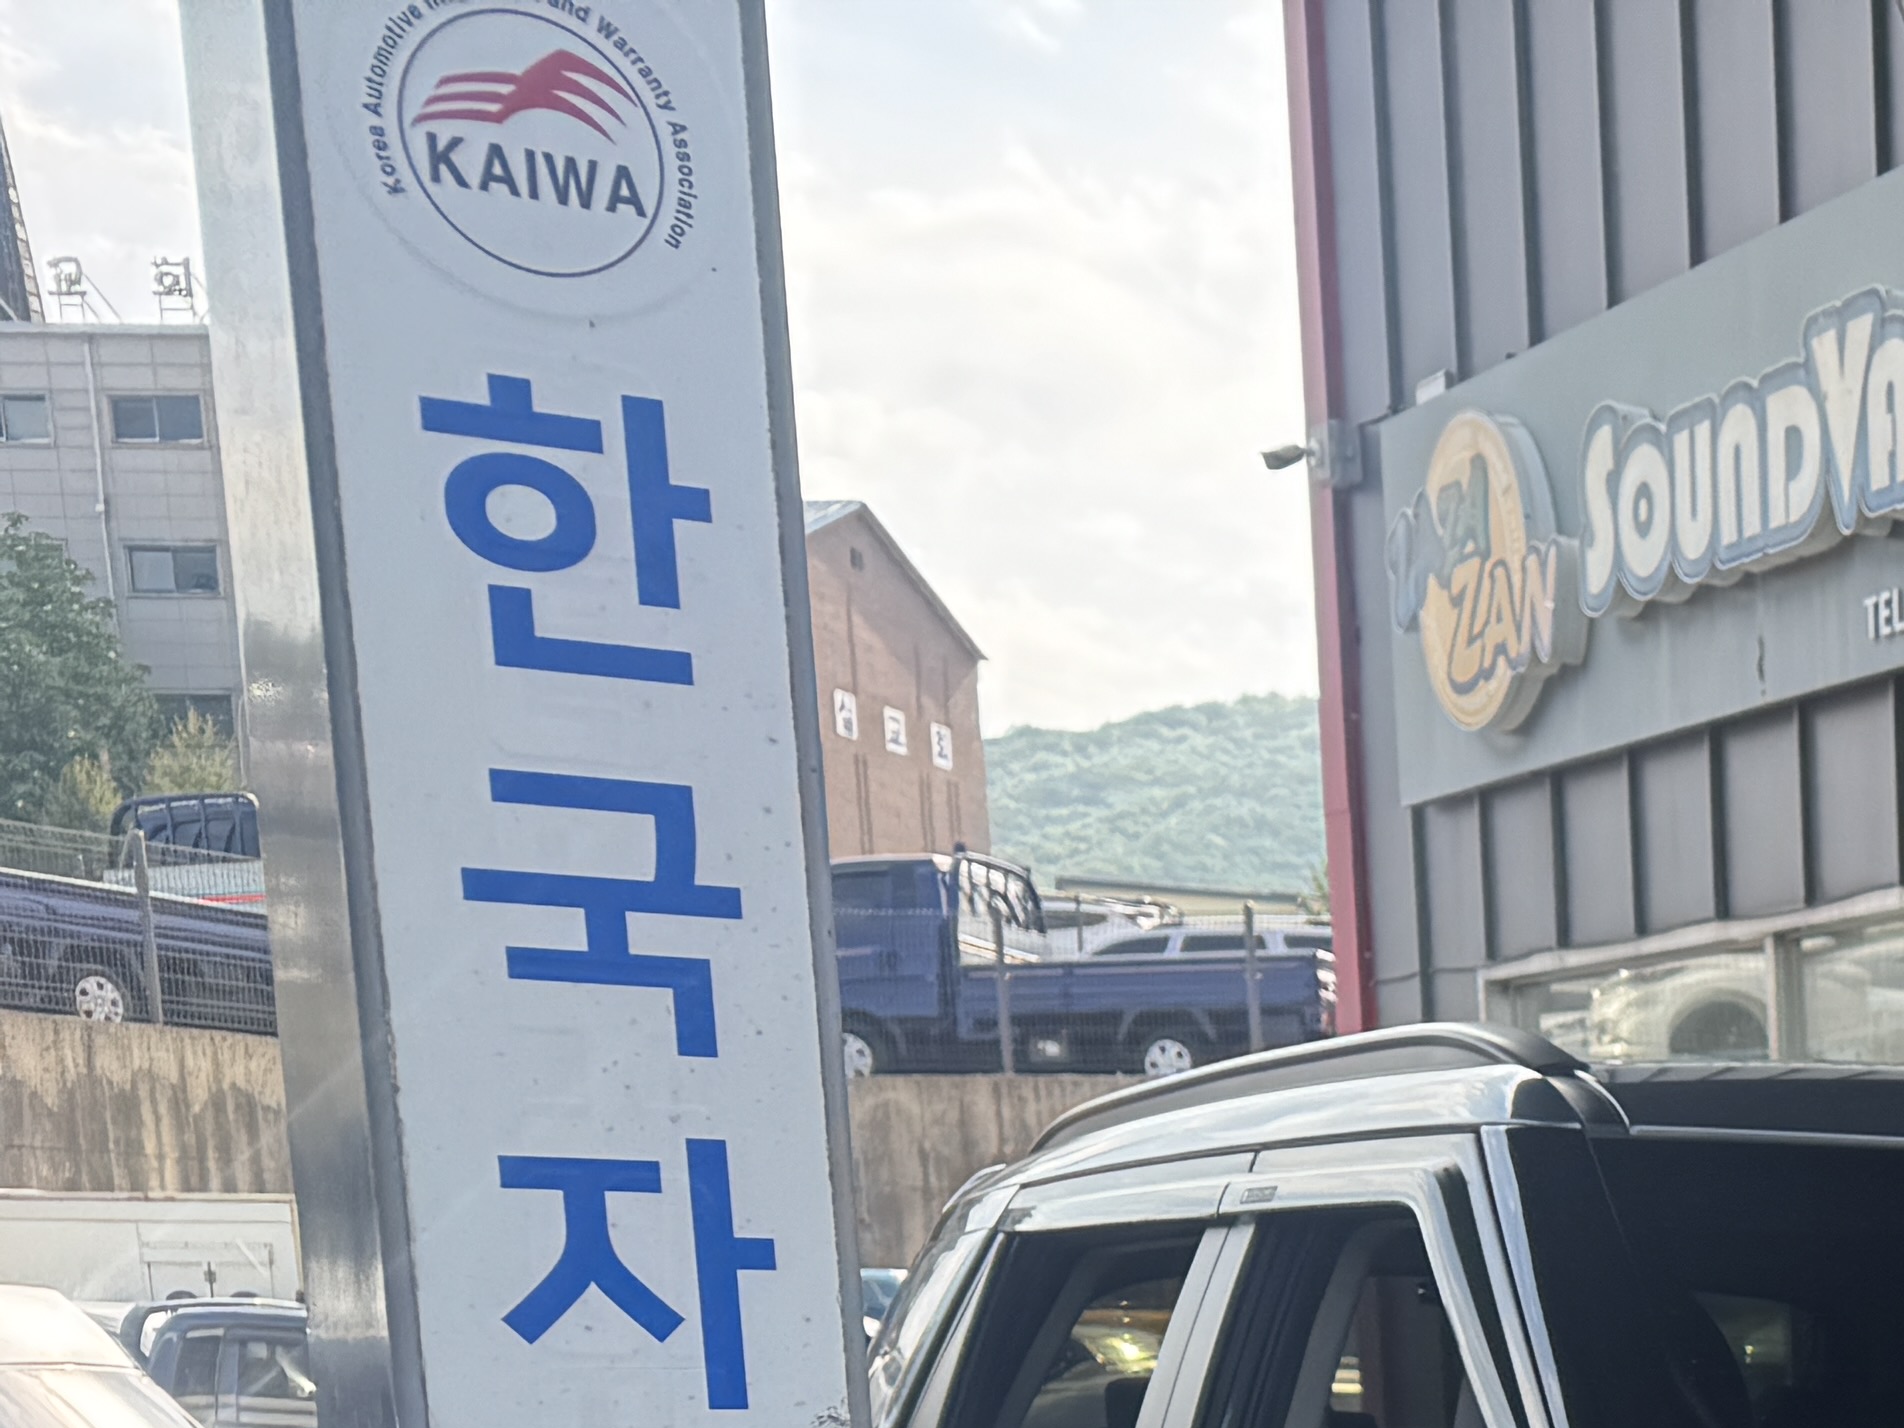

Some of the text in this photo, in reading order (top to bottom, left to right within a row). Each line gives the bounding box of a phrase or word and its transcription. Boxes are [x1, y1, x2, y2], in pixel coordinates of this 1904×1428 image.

[362, 3, 424, 118] Automotive
[597, 15, 676, 114] Warranty
[369, 125, 406, 196] Korea
[426, 131, 648, 219] KAIWA
[665, 120, 699, 250] Association
